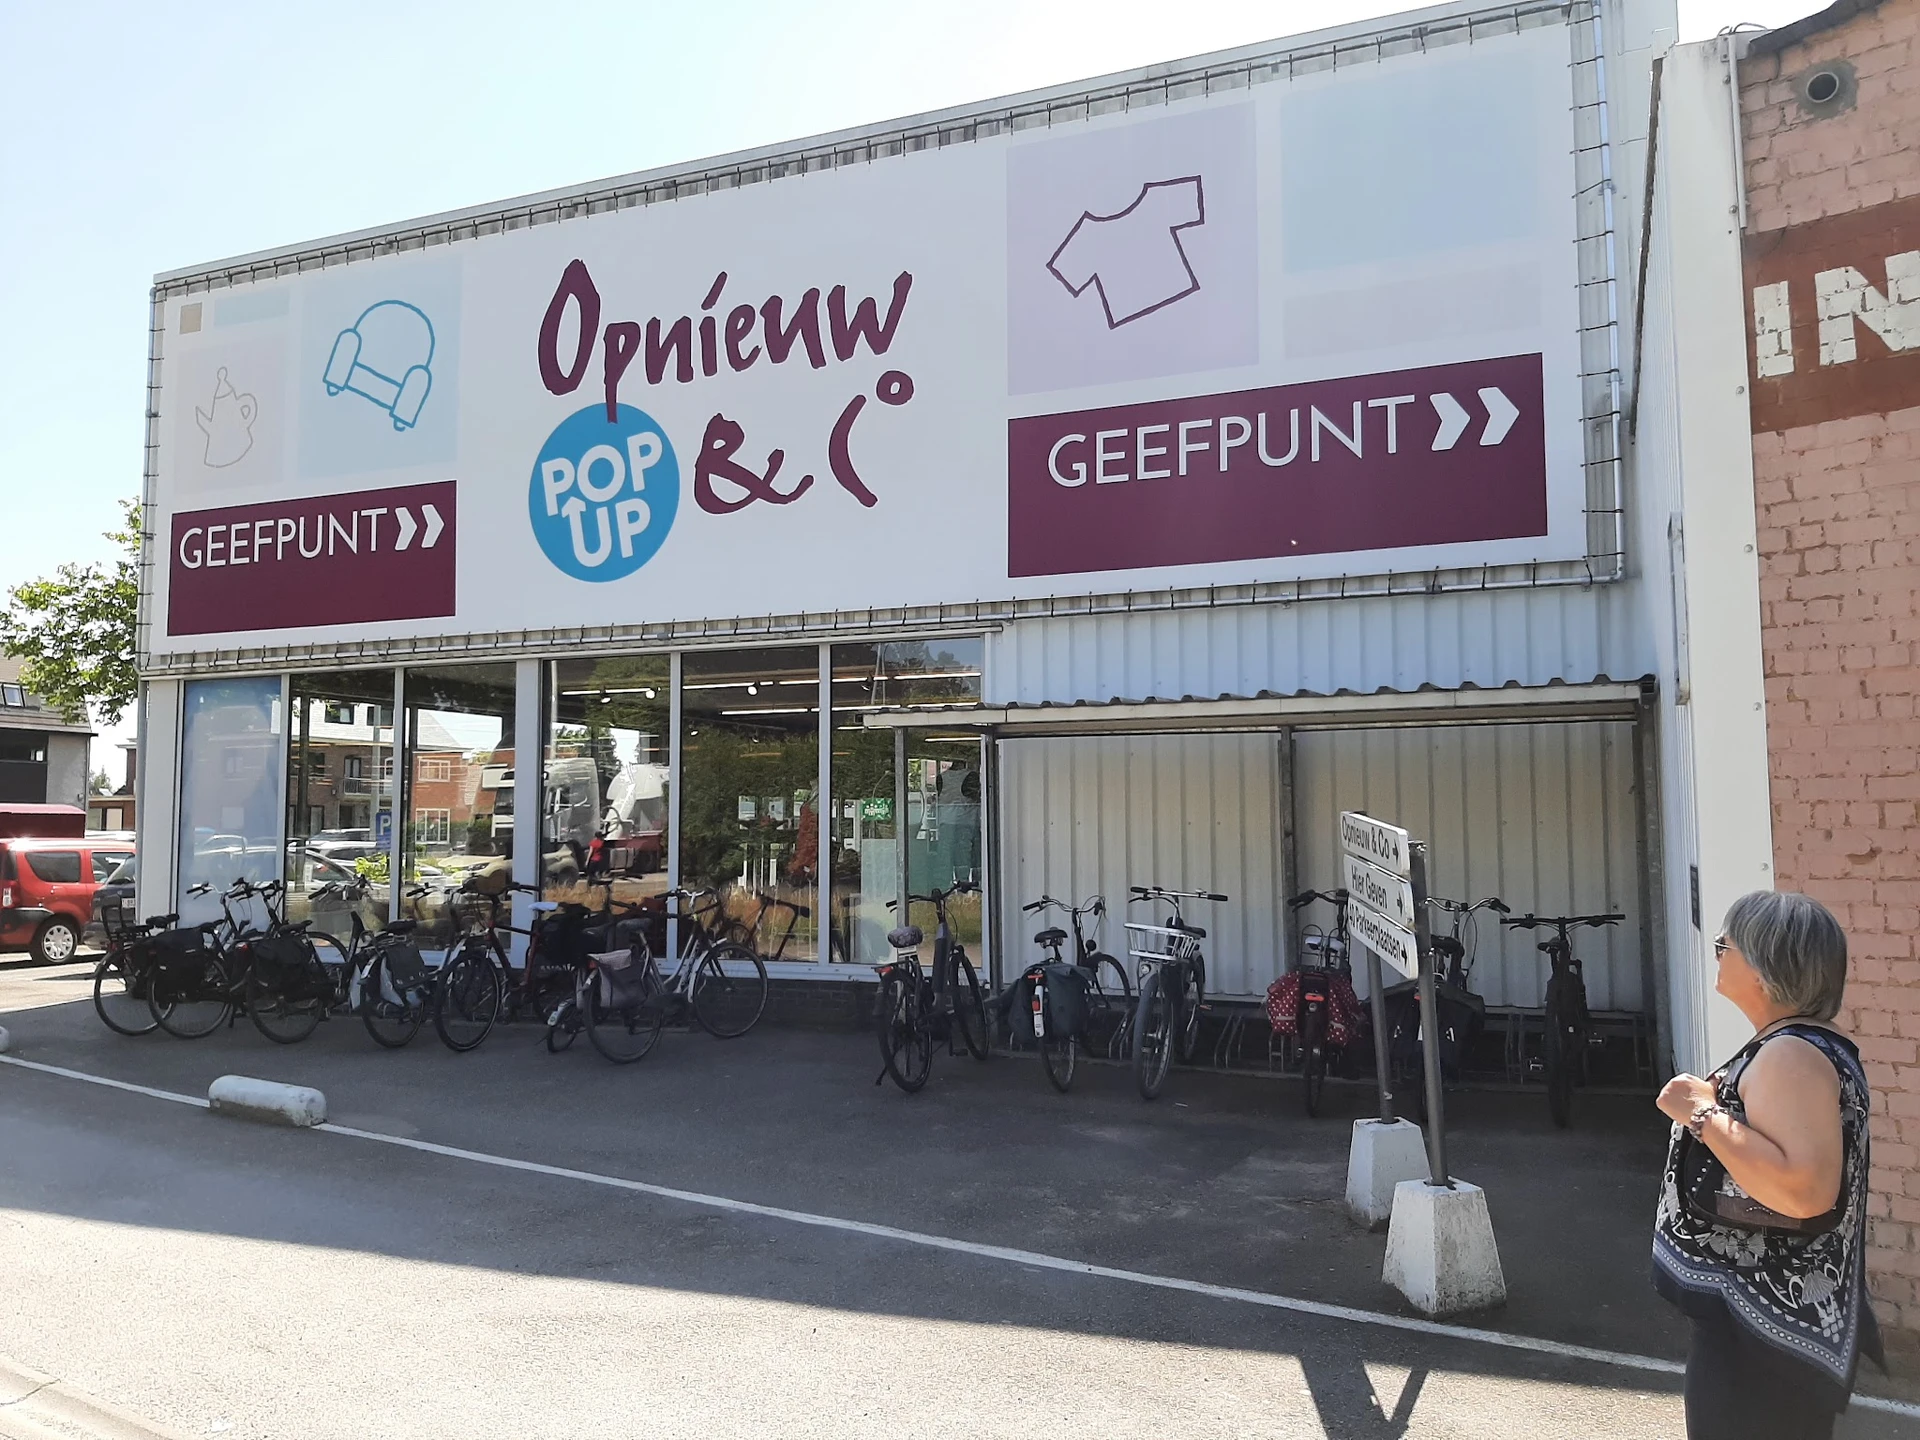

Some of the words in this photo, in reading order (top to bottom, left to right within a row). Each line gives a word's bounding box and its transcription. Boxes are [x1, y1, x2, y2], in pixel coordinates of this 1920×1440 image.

[538, 259, 913, 424] Opnieuw
[541, 431, 663, 517] POP
[694, 413, 814, 515] &
[1048, 395, 1415, 487] GEEFPUNT
[179, 507, 388, 569] GEEFPUNT
[562, 497, 651, 568] UP
[1342, 815, 1370, 850] Opnieuw
[1371, 826, 1378, 854] &
[1378, 828, 1390, 859] Co
[1352, 865, 1365, 895] Hier
[1366, 872, 1388, 909] Geven
[1355, 905, 1401, 961] Parkeerplaatsen
